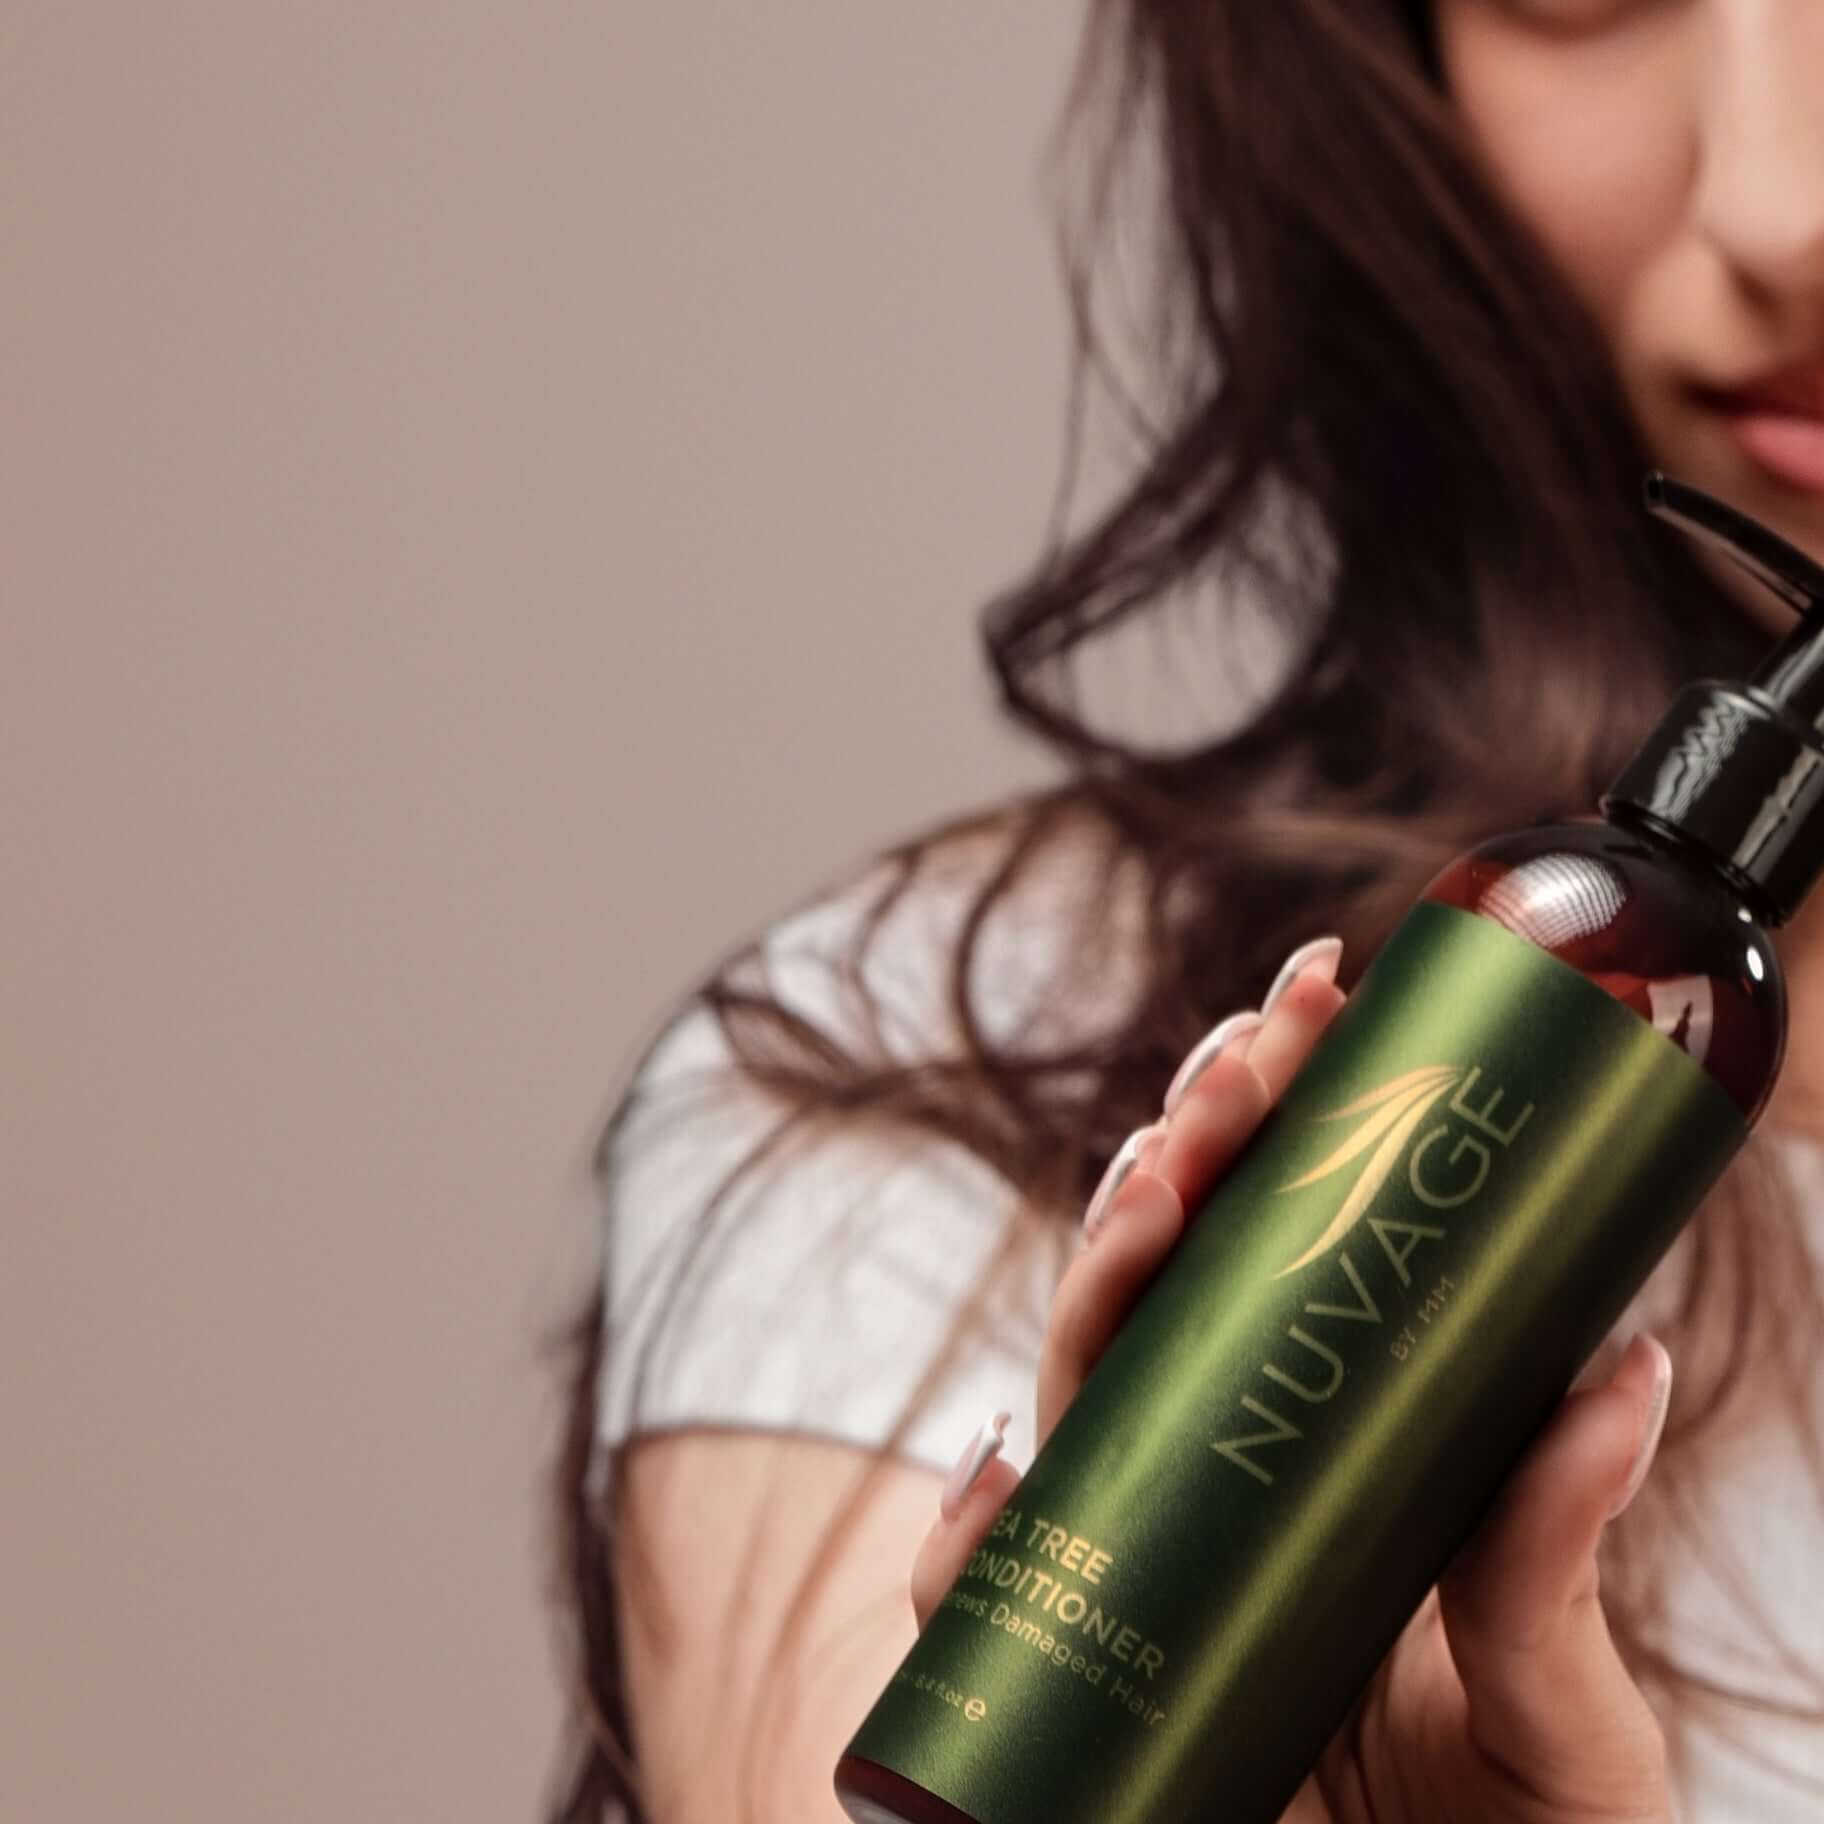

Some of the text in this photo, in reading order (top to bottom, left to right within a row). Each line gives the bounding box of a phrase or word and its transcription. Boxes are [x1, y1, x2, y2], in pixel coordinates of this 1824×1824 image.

[1209, 1065, 1536, 1487] NUVAGE
[1389, 1276, 1455, 1362] BY MM
[991, 1507, 1114, 1586] EA TREE
[962, 1548, 1165, 1679] ONDITIONER
[989, 1602, 1108, 1686] Damaged
[1108, 1677, 1166, 1726] Hair
